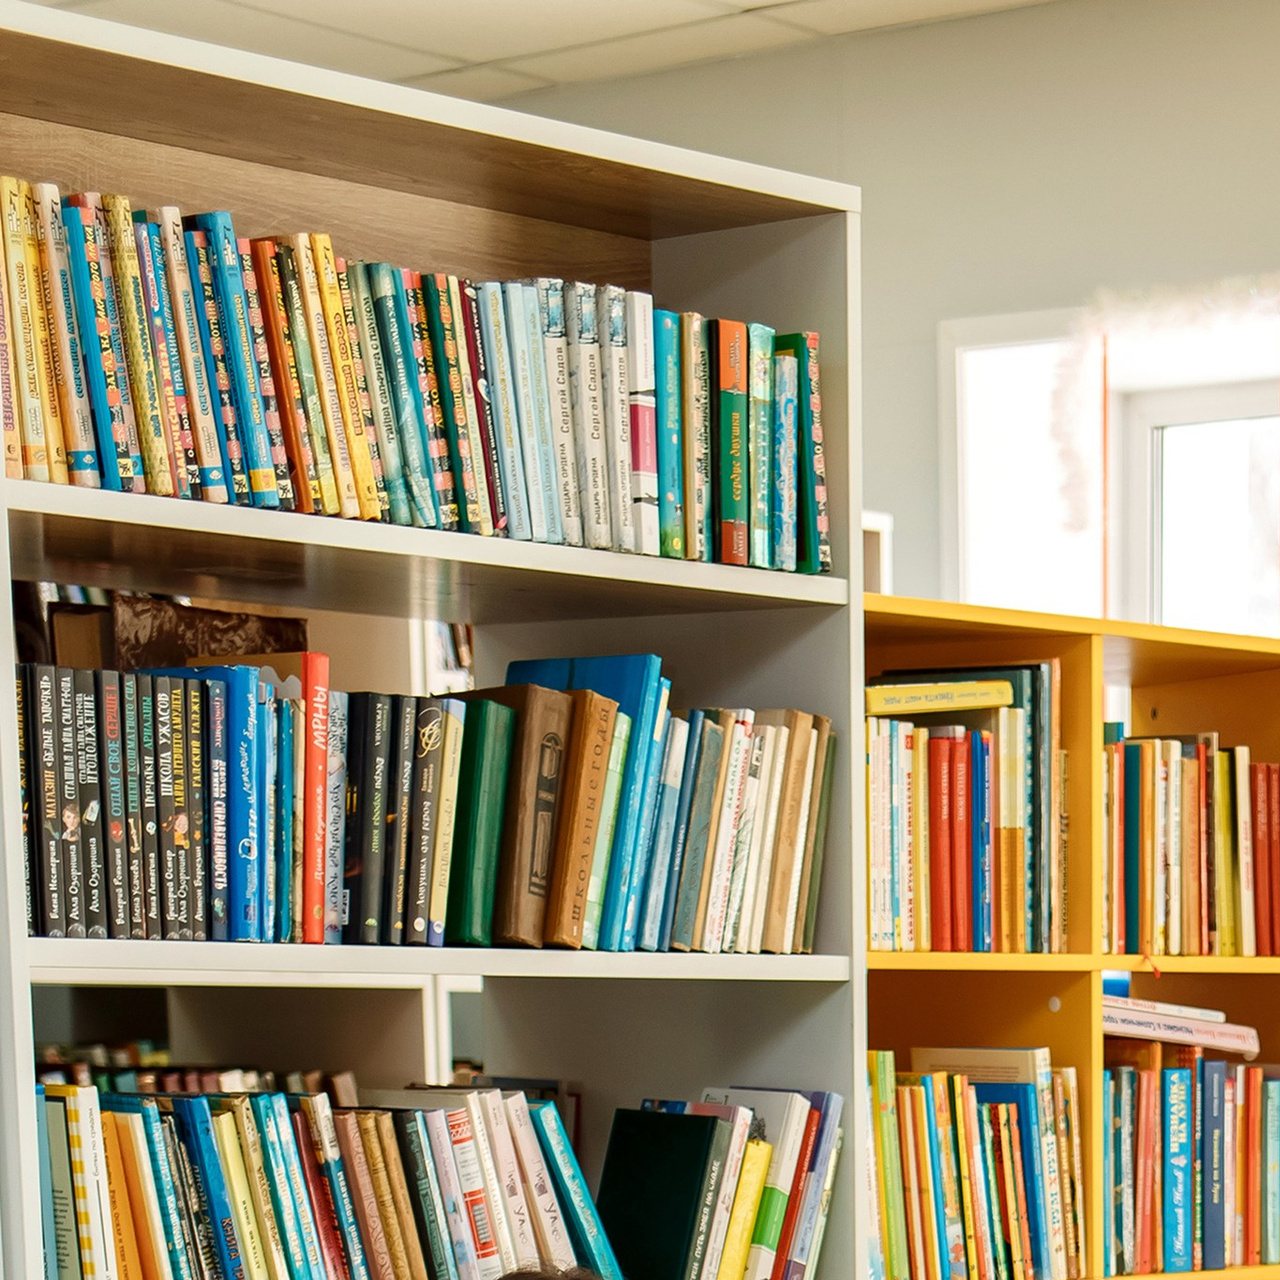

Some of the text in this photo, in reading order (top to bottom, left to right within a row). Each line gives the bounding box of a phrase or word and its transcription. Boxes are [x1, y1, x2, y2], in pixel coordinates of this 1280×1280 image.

[168, 332, 184, 390] ПРАЗДНИК
[557, 347, 571, 433] Сергей Садов
[619, 356, 628, 394] Садов
[589, 354, 602, 440] Сергей Садов
[559, 443, 572, 518] РЫЦАРЬ ОРДЕНА
[158, 693, 174, 796] ШКОЛА УЖАСОВ
[44, 771, 56, 819] МАГАЗИН
[165, 850, 177, 878] Остер
[1170, 1074, 1180, 1153] НЕЗНАЙКА
[222, 1217, 240, 1260] КНИГА
